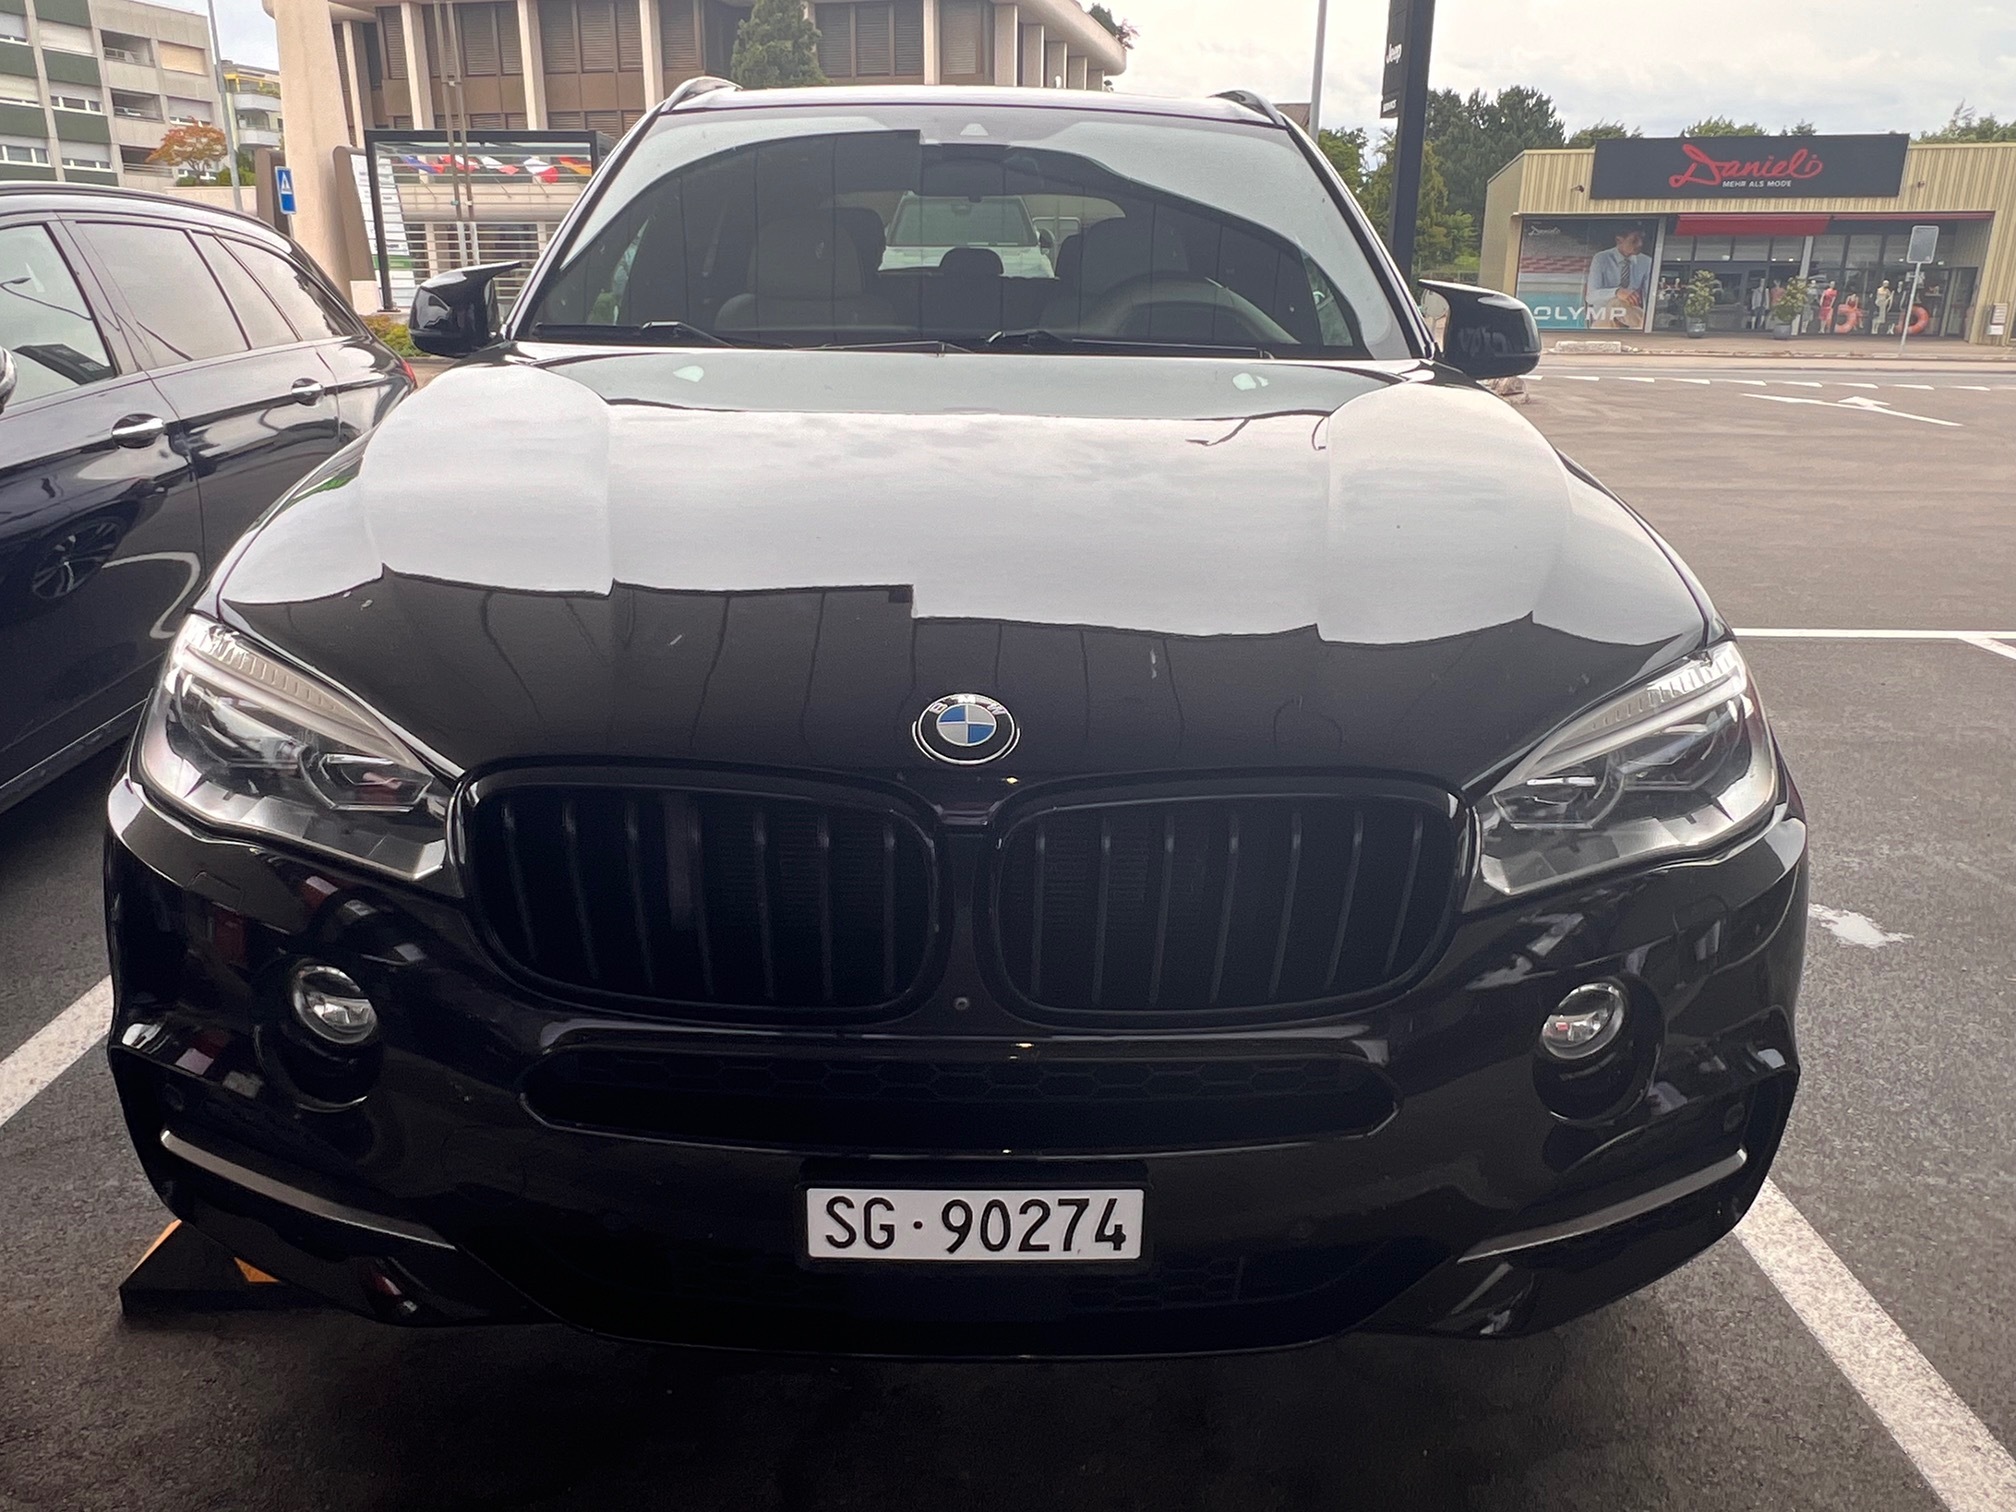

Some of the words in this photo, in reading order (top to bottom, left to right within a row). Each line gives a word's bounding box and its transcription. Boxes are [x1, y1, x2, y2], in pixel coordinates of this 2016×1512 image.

[1722, 180, 1747, 188] MEHR
[1749, 180, 1764, 188] ALS
[1766, 180, 1792, 188] MODE
[1533, 306, 1627, 321] OLYMP
[928, 692, 1007, 715] BMW
